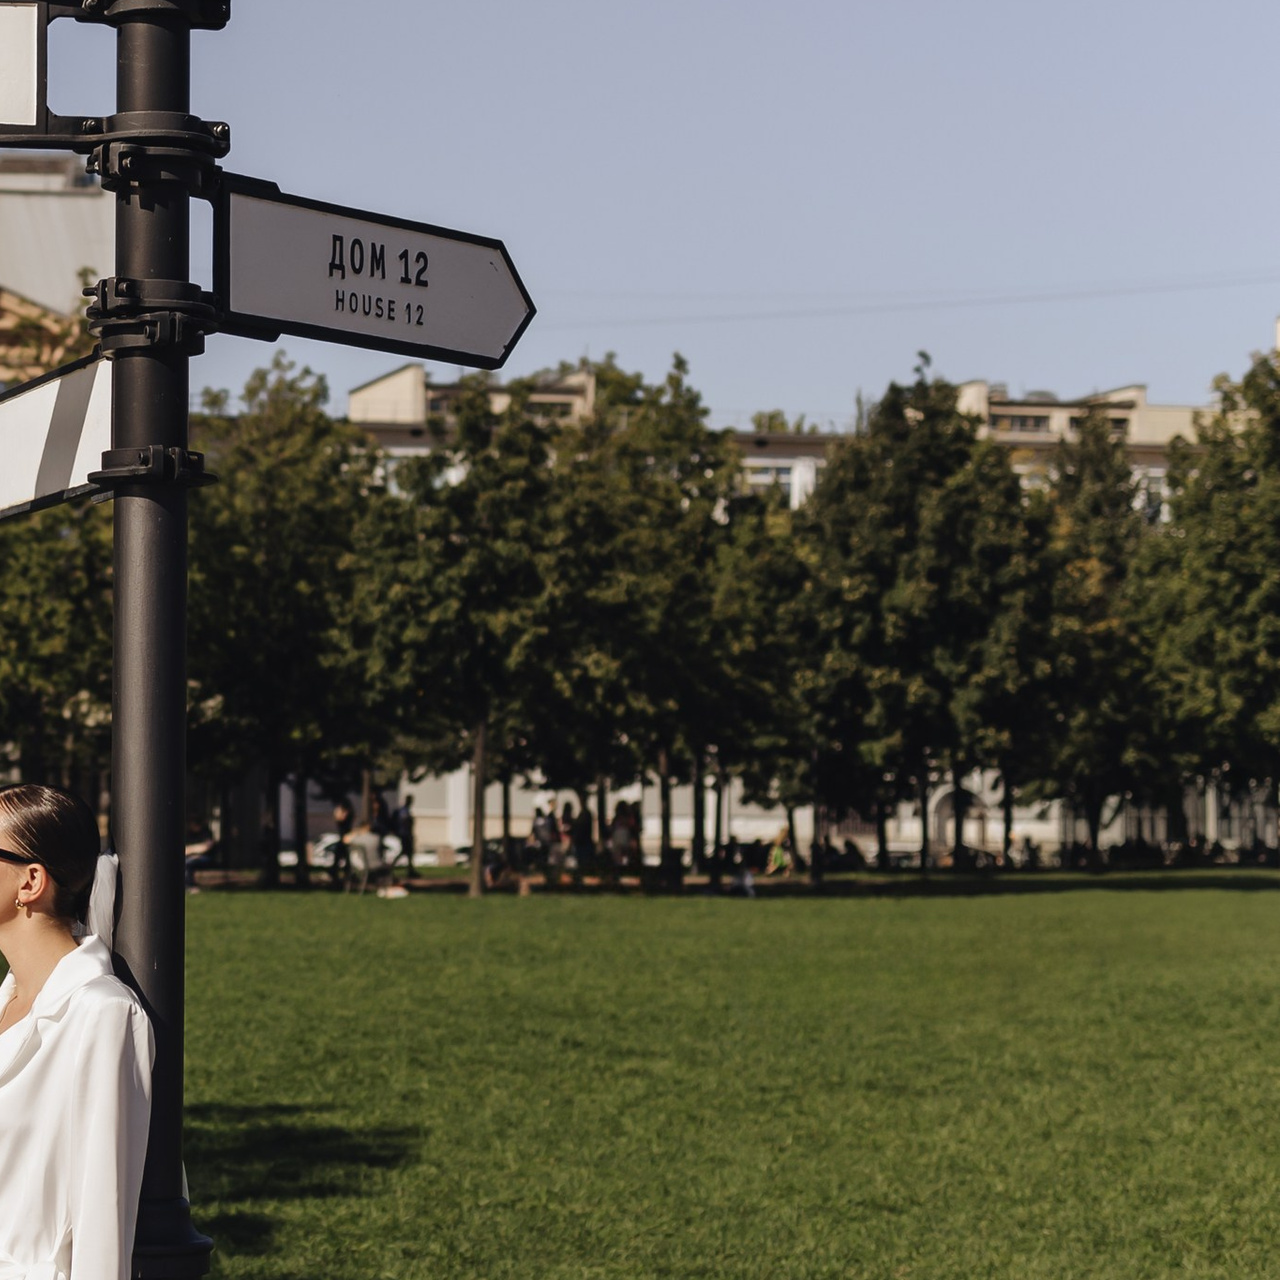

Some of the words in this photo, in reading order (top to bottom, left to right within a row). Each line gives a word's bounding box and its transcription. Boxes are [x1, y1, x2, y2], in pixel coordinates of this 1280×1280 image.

[328, 233, 386, 280] ДОМ
[398, 248, 429, 288] 12
[335, 288, 396, 322] HOUSE
[405, 302, 424, 326] 12
